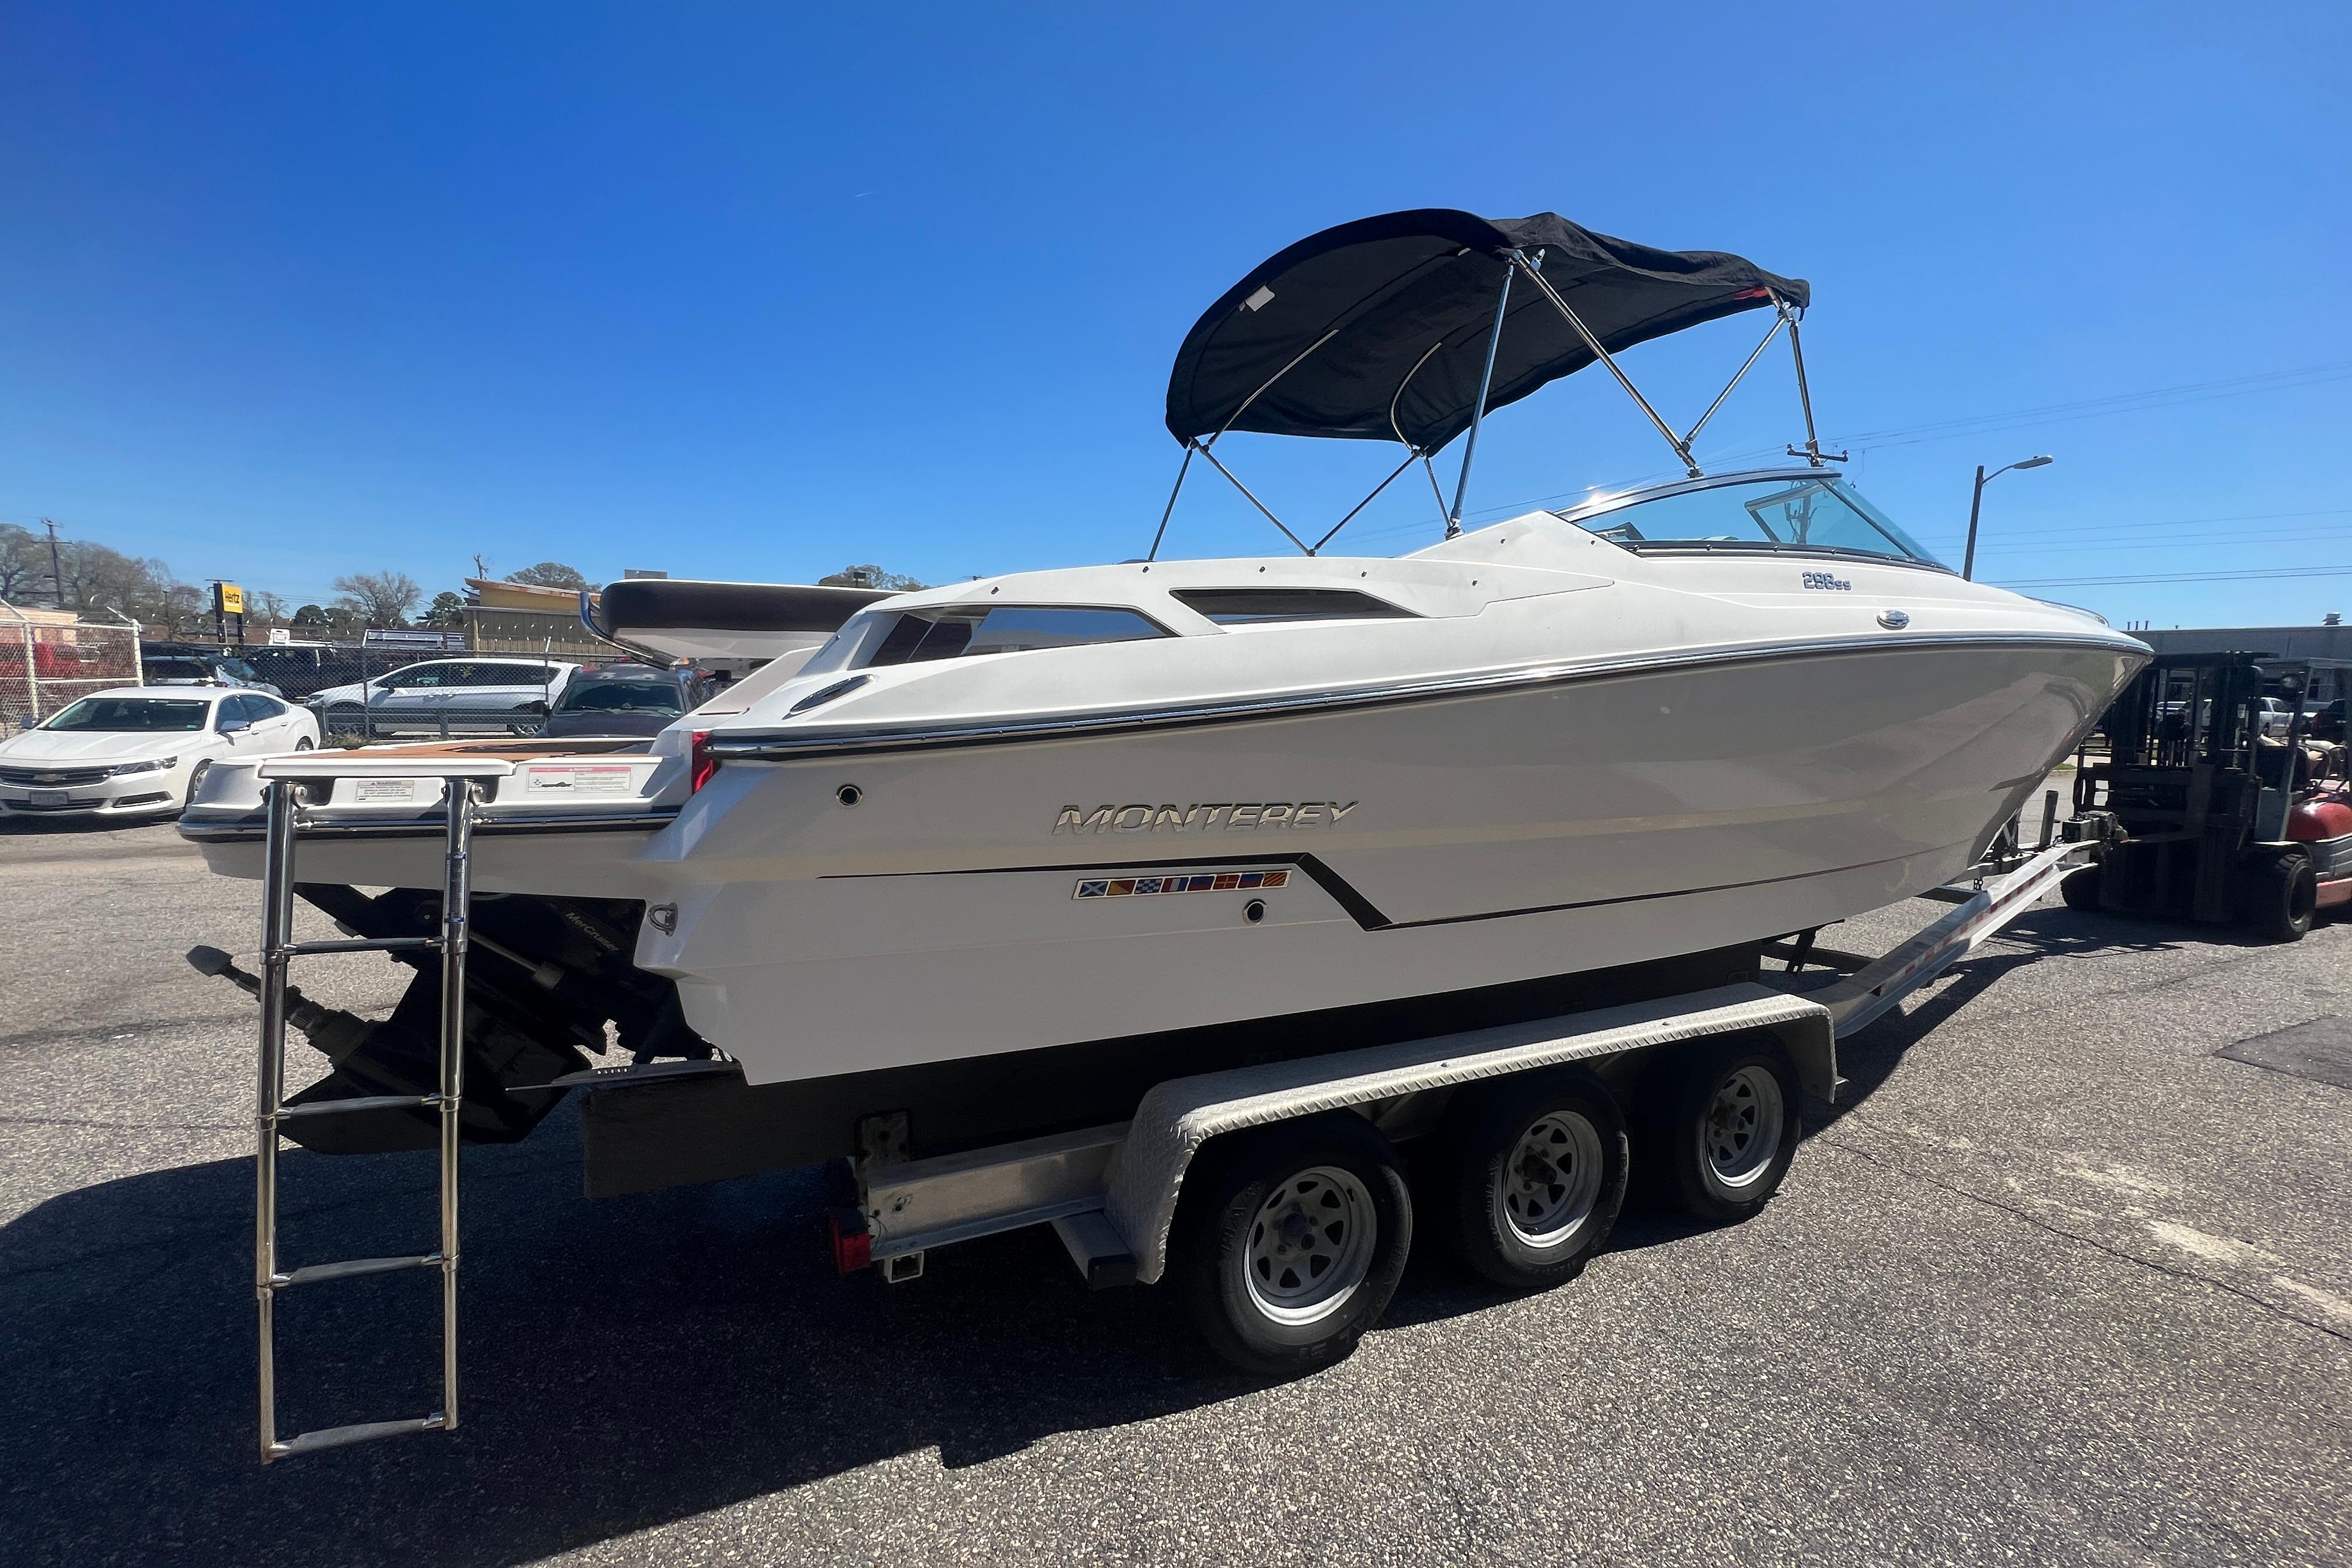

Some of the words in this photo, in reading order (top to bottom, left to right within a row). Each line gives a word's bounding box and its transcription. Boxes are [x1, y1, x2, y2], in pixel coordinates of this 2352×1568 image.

[225, 591, 240, 604] Hertz
[1052, 801, 1359, 835] MONTEREY
[565, 912, 620, 951] MerCruiser
